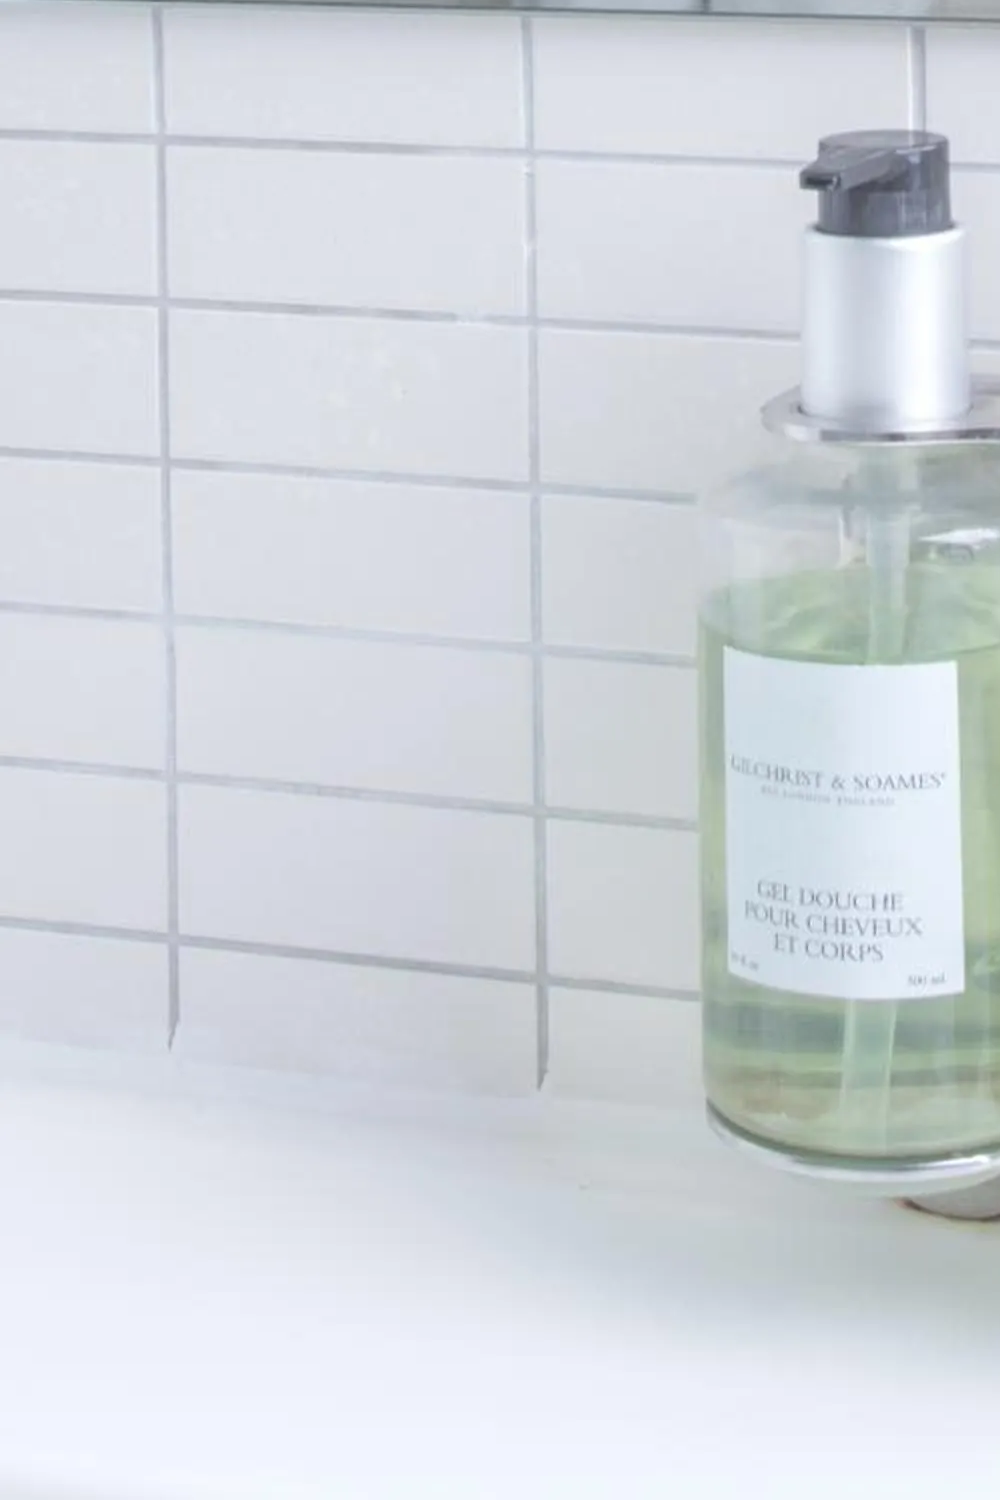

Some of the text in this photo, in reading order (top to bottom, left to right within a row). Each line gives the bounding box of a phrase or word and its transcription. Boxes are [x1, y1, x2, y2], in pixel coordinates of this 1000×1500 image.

[730, 753, 825, 788] GILCHRIST
[831, 773, 845, 790] &
[757, 879, 904, 913] GEL DOUCHE
[744, 898, 924, 938] POUR CHEVEUX
[773, 931, 885, 962] ET CORPS
